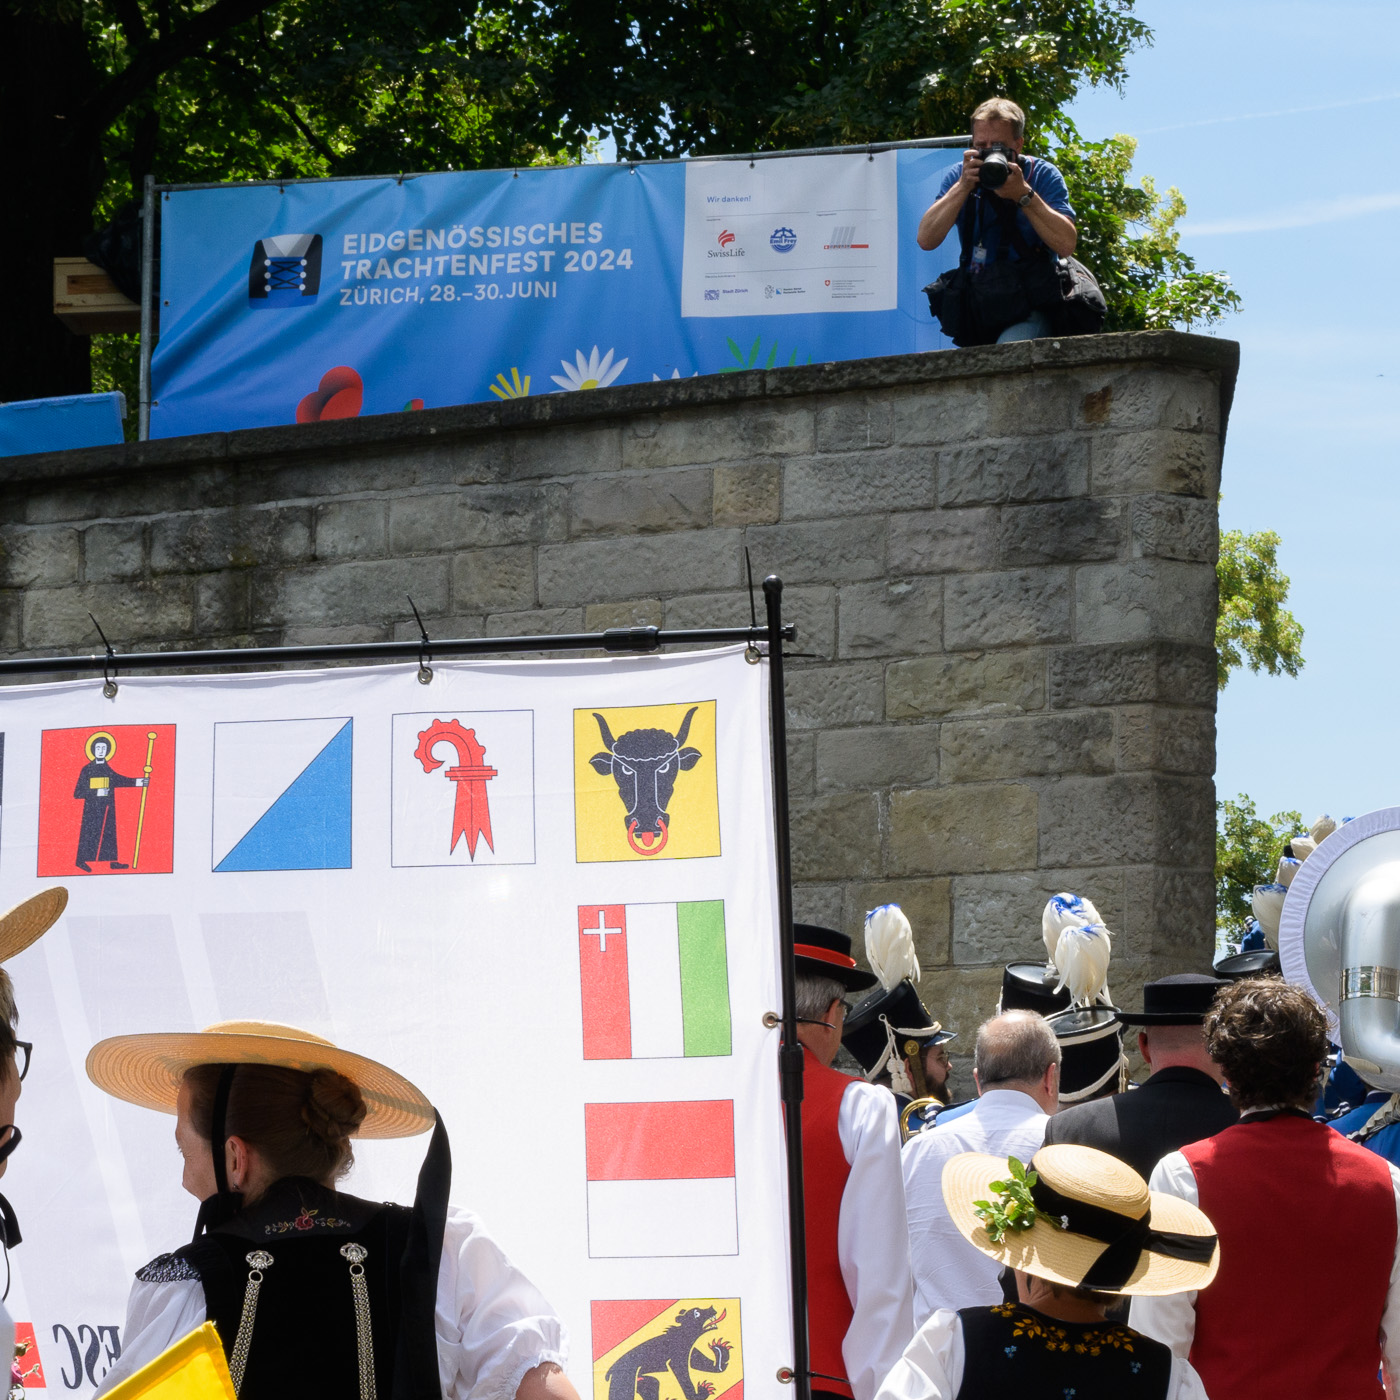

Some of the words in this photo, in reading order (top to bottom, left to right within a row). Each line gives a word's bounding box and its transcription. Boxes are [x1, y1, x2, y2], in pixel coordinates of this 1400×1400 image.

[721, 195, 751, 203] danken!
[343, 222, 603, 255] EIDGENÖSSISCHES
[707, 248, 745, 258] SwissLife
[341, 250, 555, 280] TRACHTENFEST
[564, 249, 633, 272] 2024
[340, 286, 425, 306] ZÜRICH,
